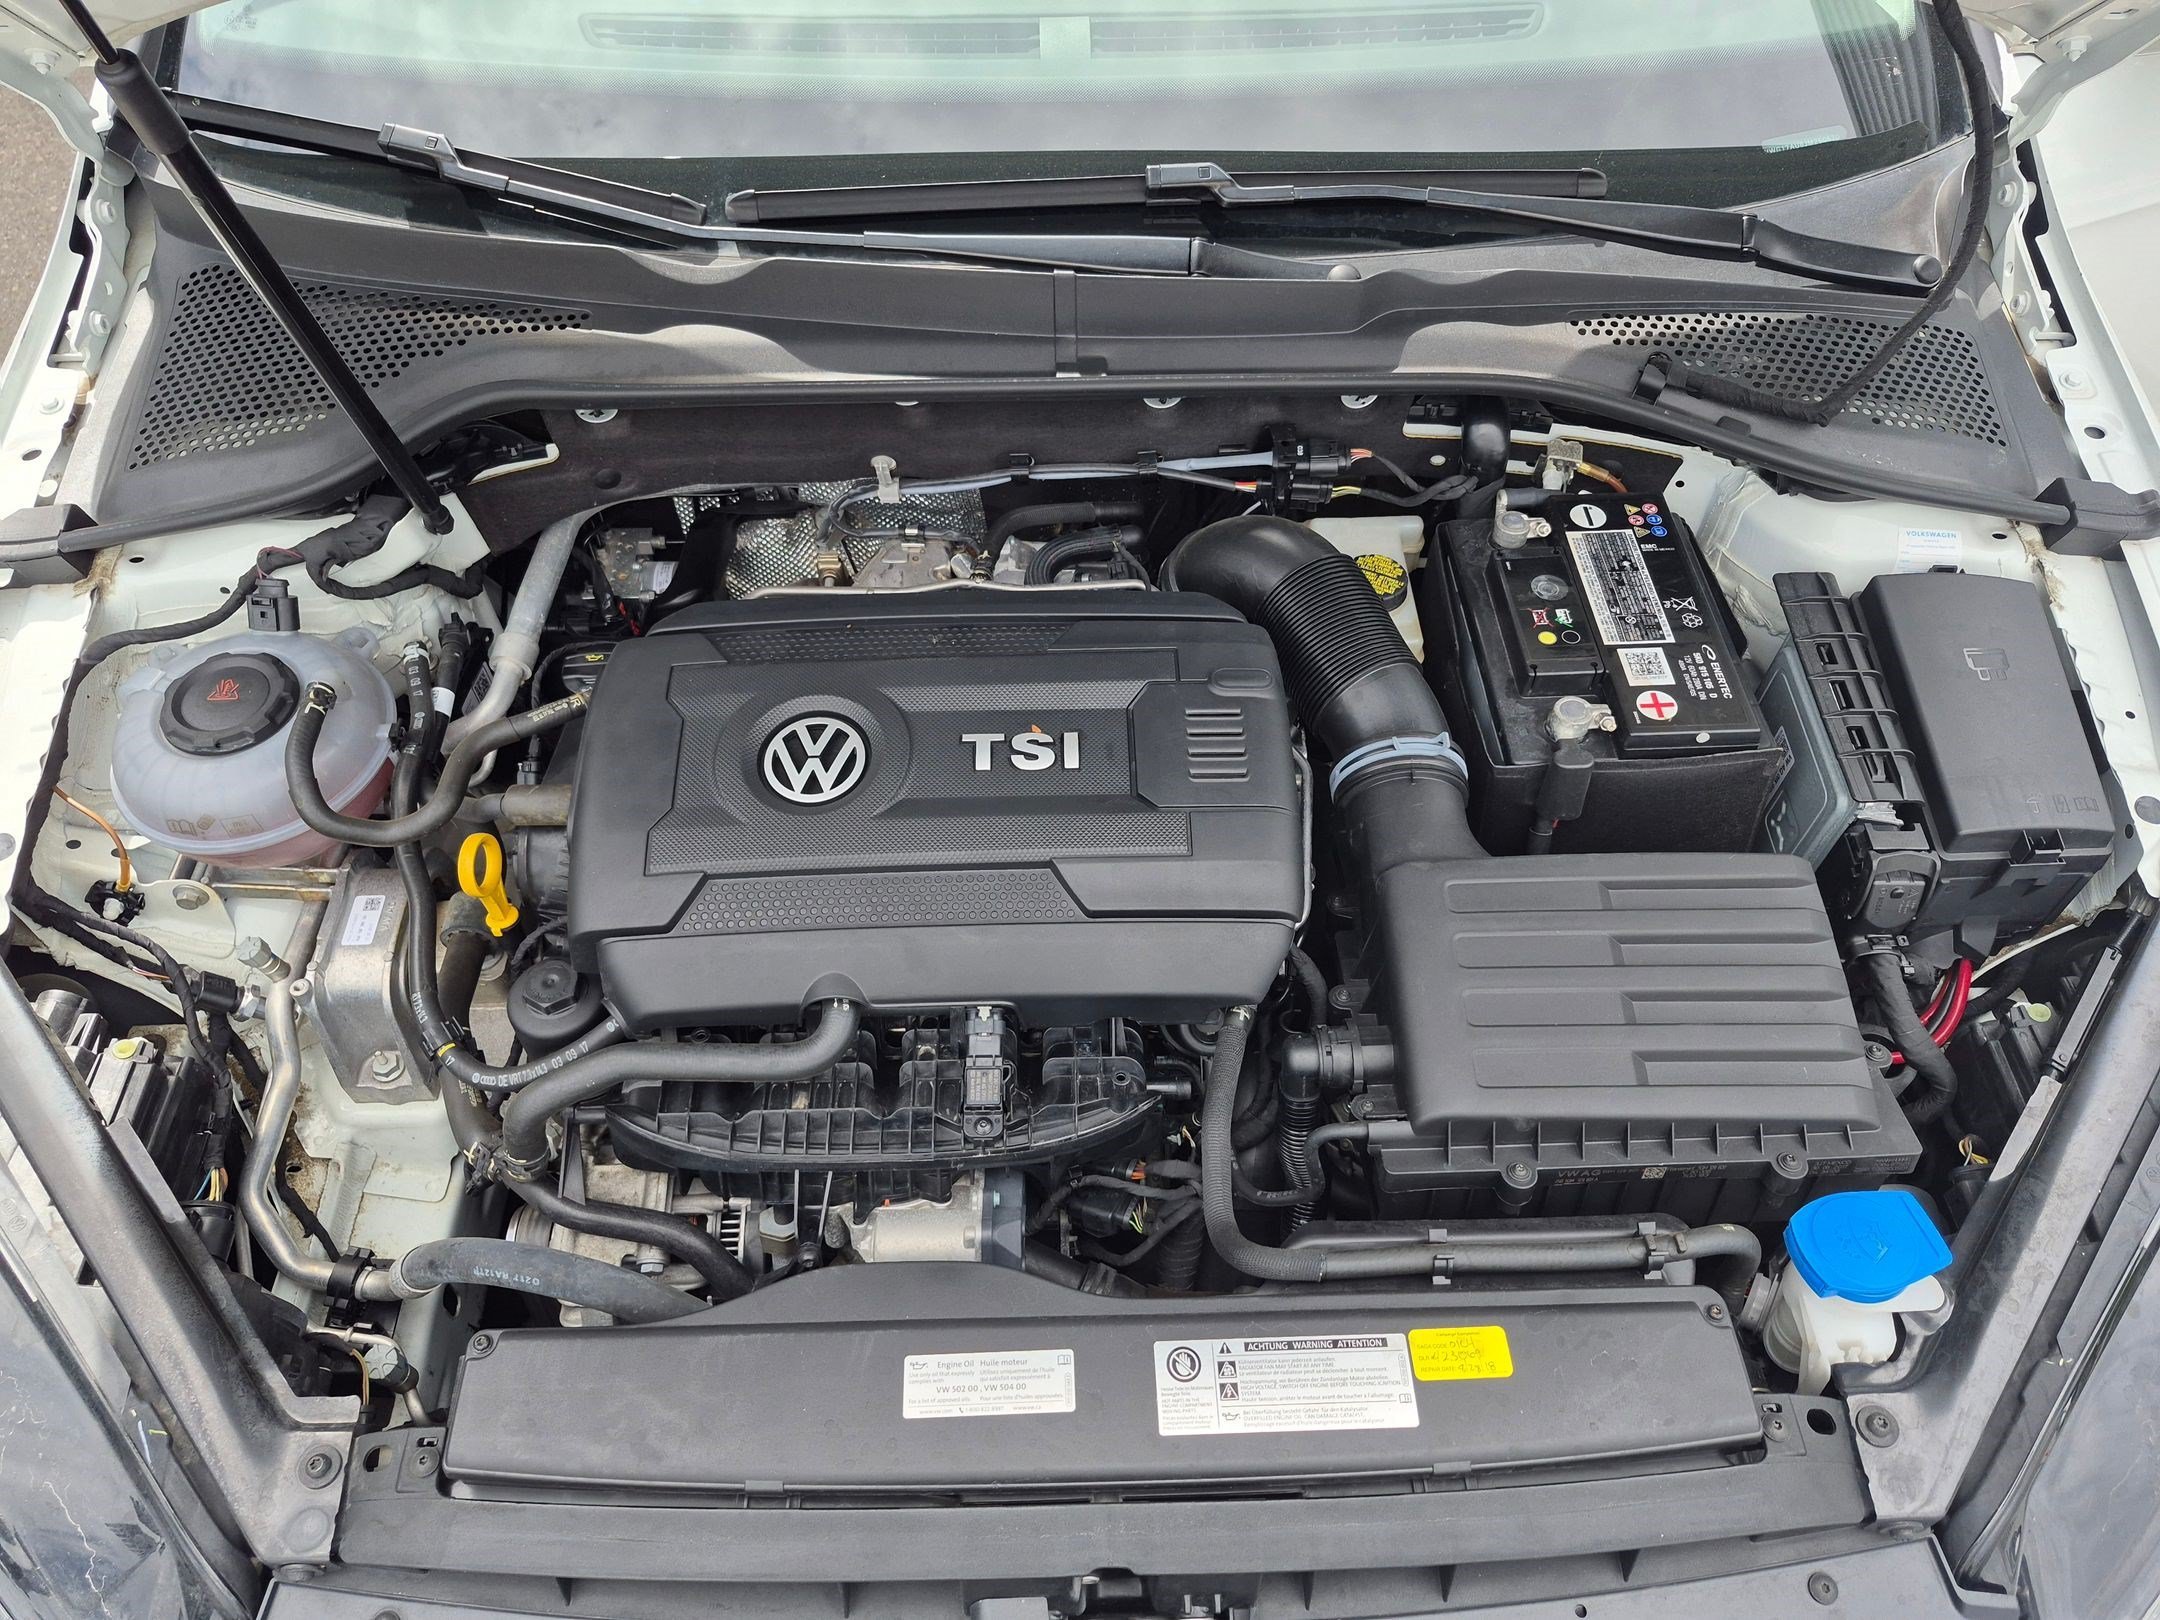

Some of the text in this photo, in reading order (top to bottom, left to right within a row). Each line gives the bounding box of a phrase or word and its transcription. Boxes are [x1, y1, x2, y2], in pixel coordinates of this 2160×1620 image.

[1906, 530, 1957, 539] VOLKSWAGEN
[1710, 662, 1733, 699] ENERTEC
[961, 731, 1080, 772] TSI
[498, 1074, 509, 1087] DE
[551, 1056, 564, 1069] 03
[566, 1048, 578, 1062] 09
[579, 1040, 590, 1053] 17
[1247, 1338, 1383, 1351] ACHTUNG WARNING ATTENTION
[937, 1359, 975, 1370] Engine Oil
[980, 1359, 1028, 1367] Huile moteur
[952, 1384, 966, 1393] 502
[967, 1384, 979, 1392] 00
[983, 1384, 998, 1392] VW
[999, 1383, 1014, 1391] 504
[1015, 1382, 1027, 1390] 00
